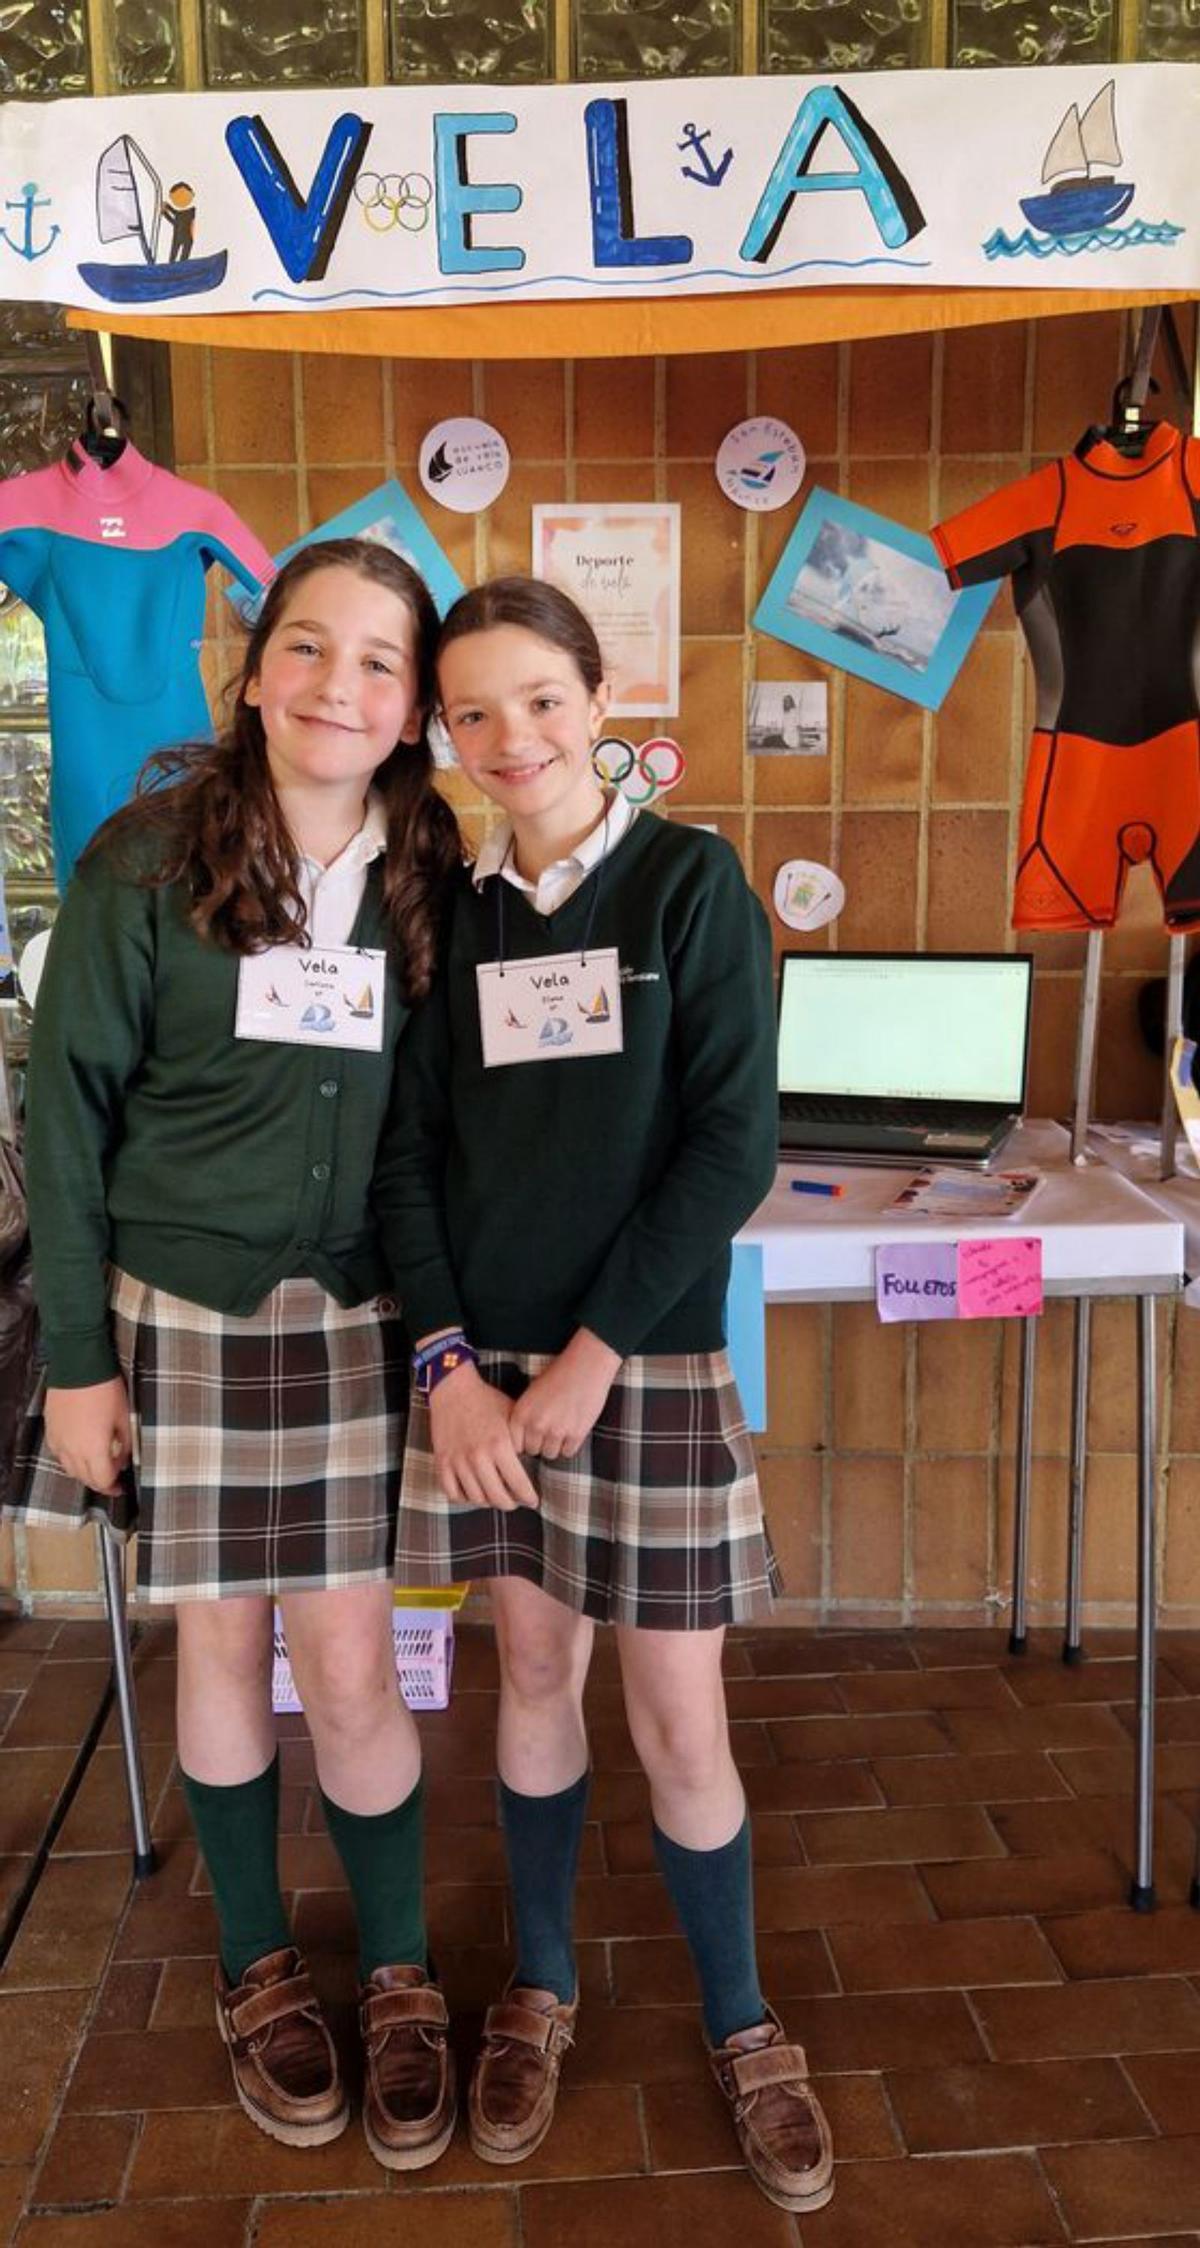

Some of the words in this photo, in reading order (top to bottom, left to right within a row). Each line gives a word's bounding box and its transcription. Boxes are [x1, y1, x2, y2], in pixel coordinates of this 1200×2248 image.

[225, 85, 926, 283] VELA
[575, 554, 635, 570] Deporte
[298, 958, 339, 975] Vela
[529, 971, 571, 990] Vela
[882, 1273, 957, 1299] FOLLETOS
